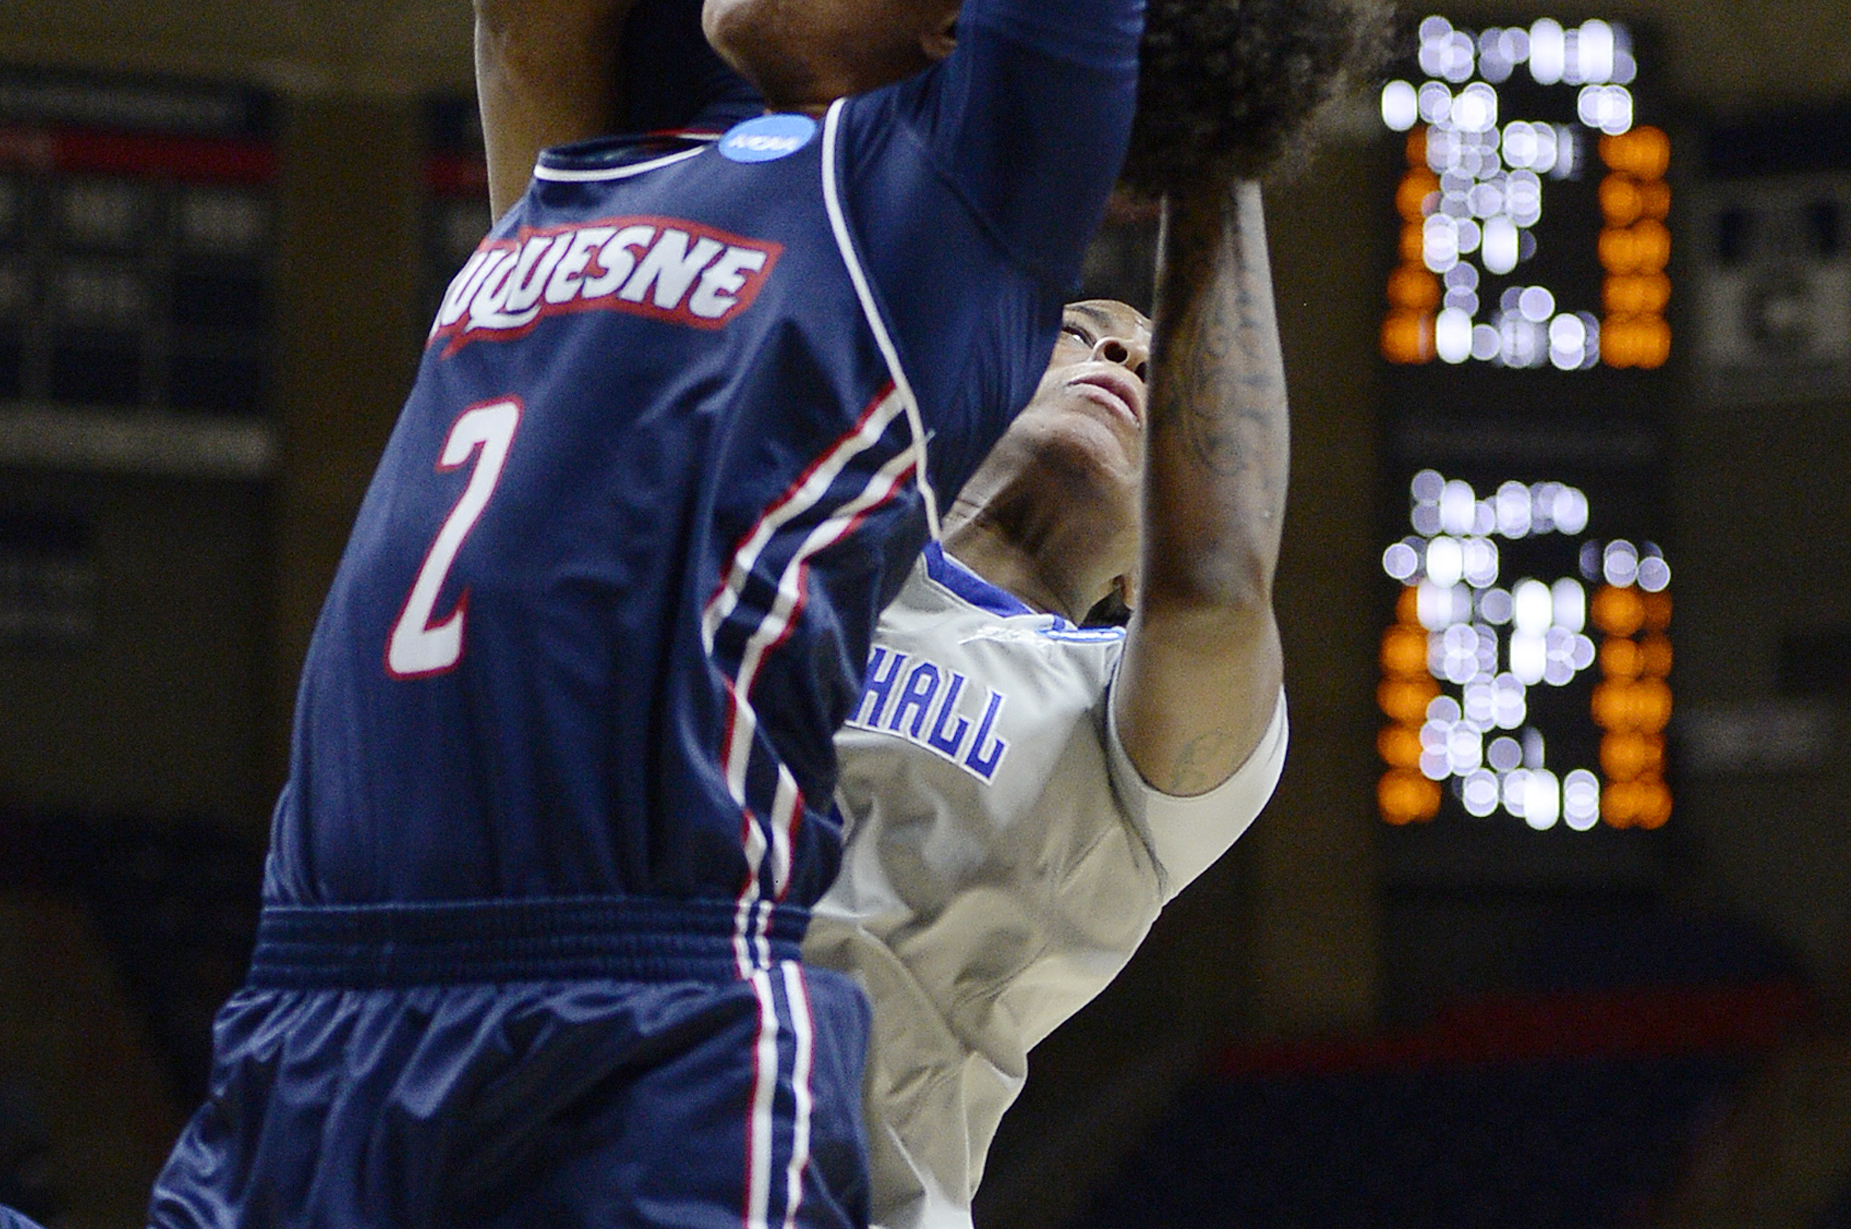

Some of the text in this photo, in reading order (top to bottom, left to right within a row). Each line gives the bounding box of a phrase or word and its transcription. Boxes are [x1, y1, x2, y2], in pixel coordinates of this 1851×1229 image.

[433, 223, 769, 334] UQUESNE
[386, 395, 522, 678] 2
[847, 645, 1007, 782] HALL
